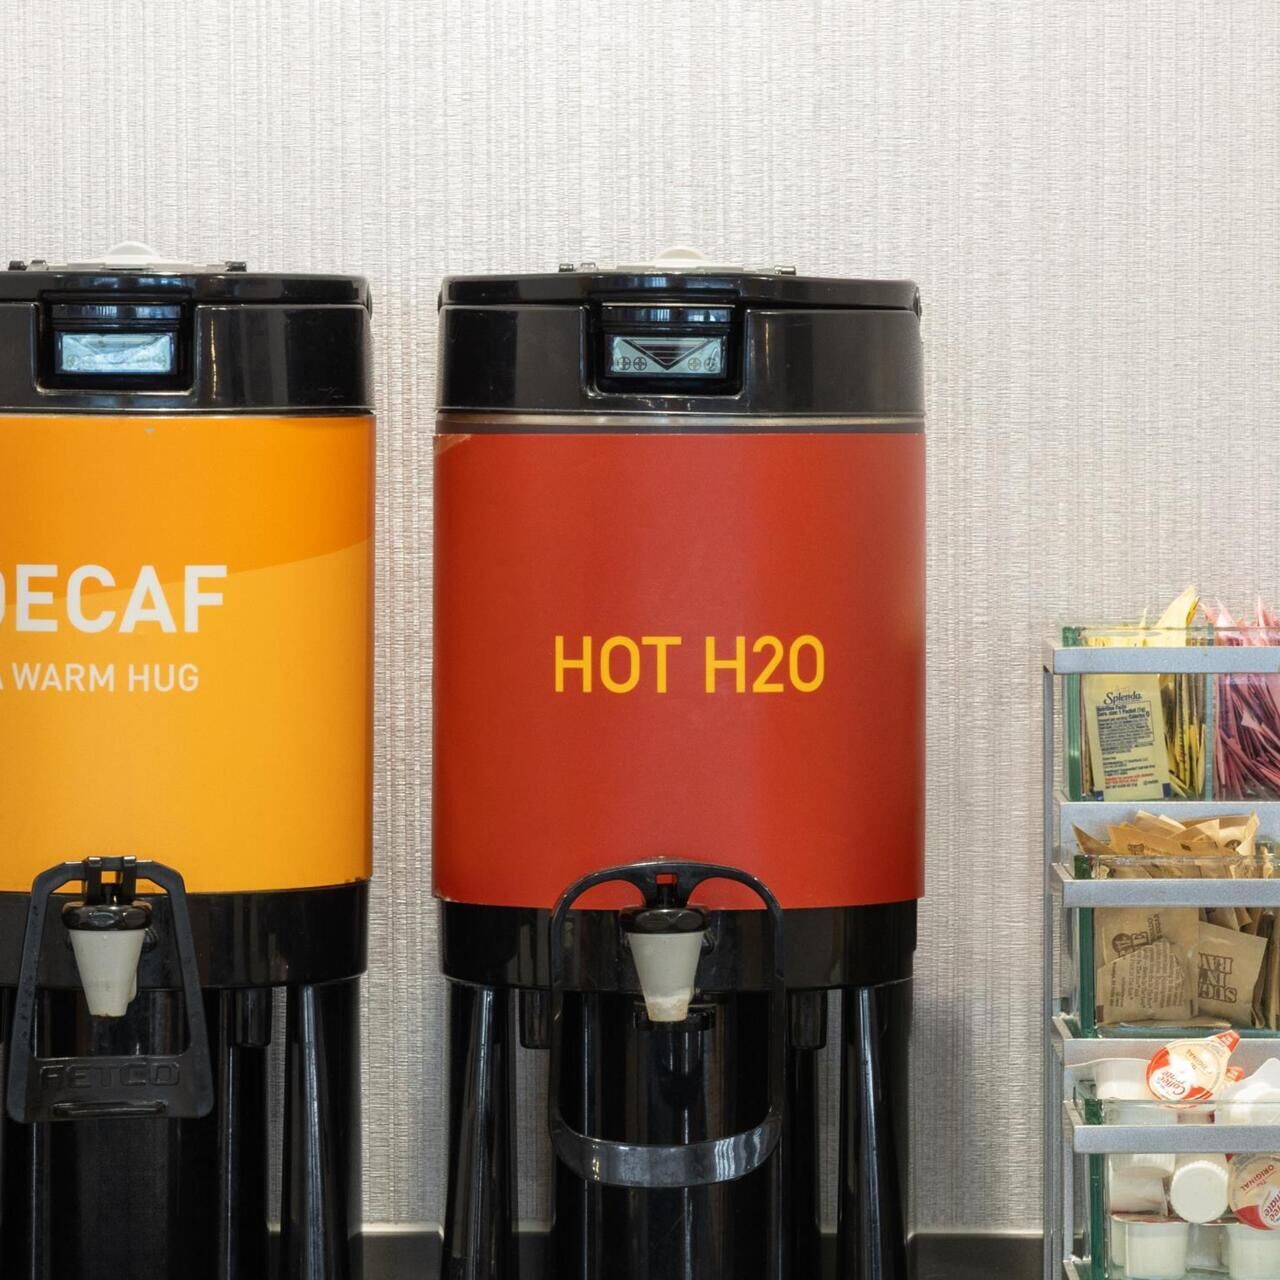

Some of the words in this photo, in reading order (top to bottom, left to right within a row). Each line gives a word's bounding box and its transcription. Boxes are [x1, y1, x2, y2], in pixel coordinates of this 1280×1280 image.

[12, 662, 115, 692] WARM
[128, 663, 200, 693] HUG
[555, 635, 682, 694] HOT
[1240, 1164, 1275, 1193] ORIGINAL
